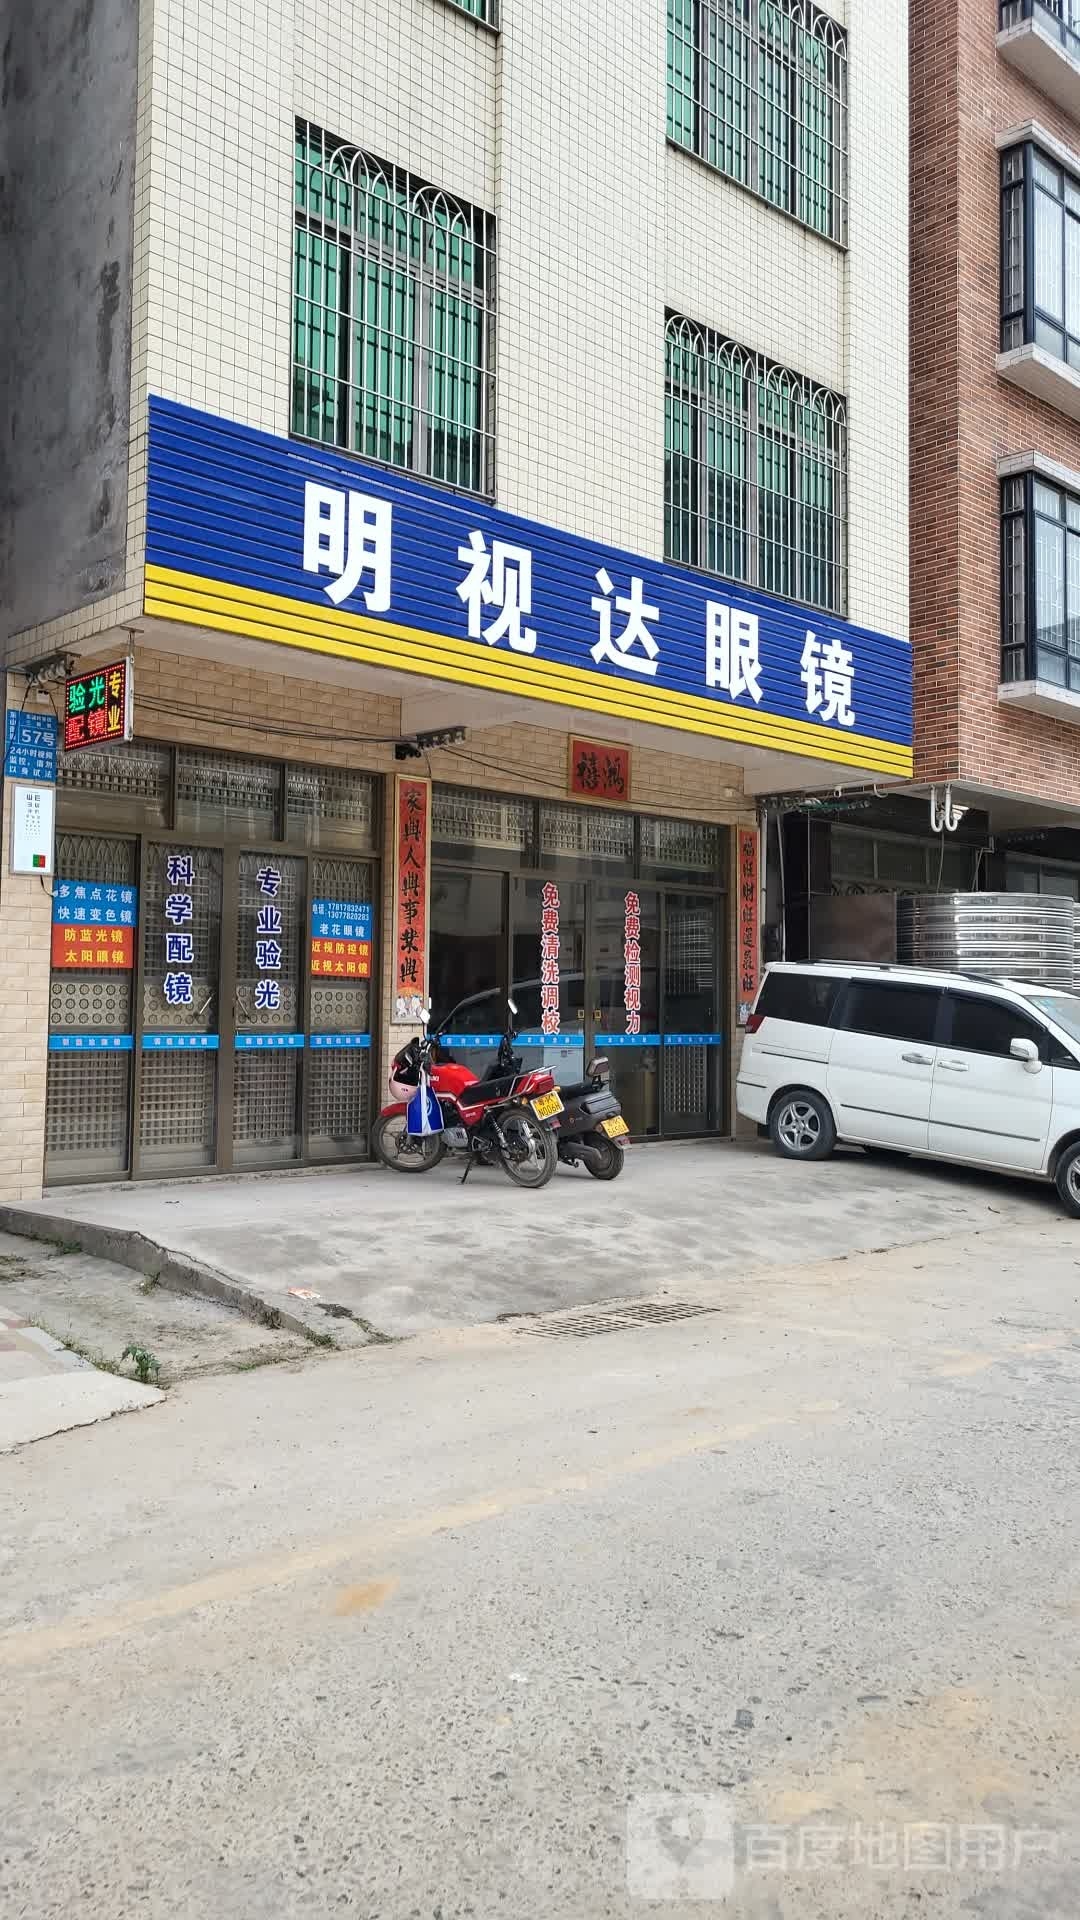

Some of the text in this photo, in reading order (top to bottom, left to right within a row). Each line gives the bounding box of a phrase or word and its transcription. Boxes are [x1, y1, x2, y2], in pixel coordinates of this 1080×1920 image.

[303, 480, 855, 728] 明视达眼镜
[69, 676, 105, 713] 验光
[108, 671, 121, 732] 专业
[22, 729, 55, 747] 57号
[68, 709, 105, 743] 配镜
[59, 884, 133, 904] 多焦点花镜
[58, 906, 132, 923] 快速变色镜
[64, 928, 124, 944] 防蓝光镜
[164, 854, 195, 1004] 科学配镜
[255, 866, 282, 1010] 专业验光
[320, 922, 365, 938] 老花眼镜
[65, 949, 125, 964] 太阳眼镜
[312, 940, 369, 956] 近视防控镜
[541, 881, 560, 1035] 免费清洗调校
[311, 959, 368, 974] 近视太阳镜
[624, 891, 641, 1035] 免费检测视力
